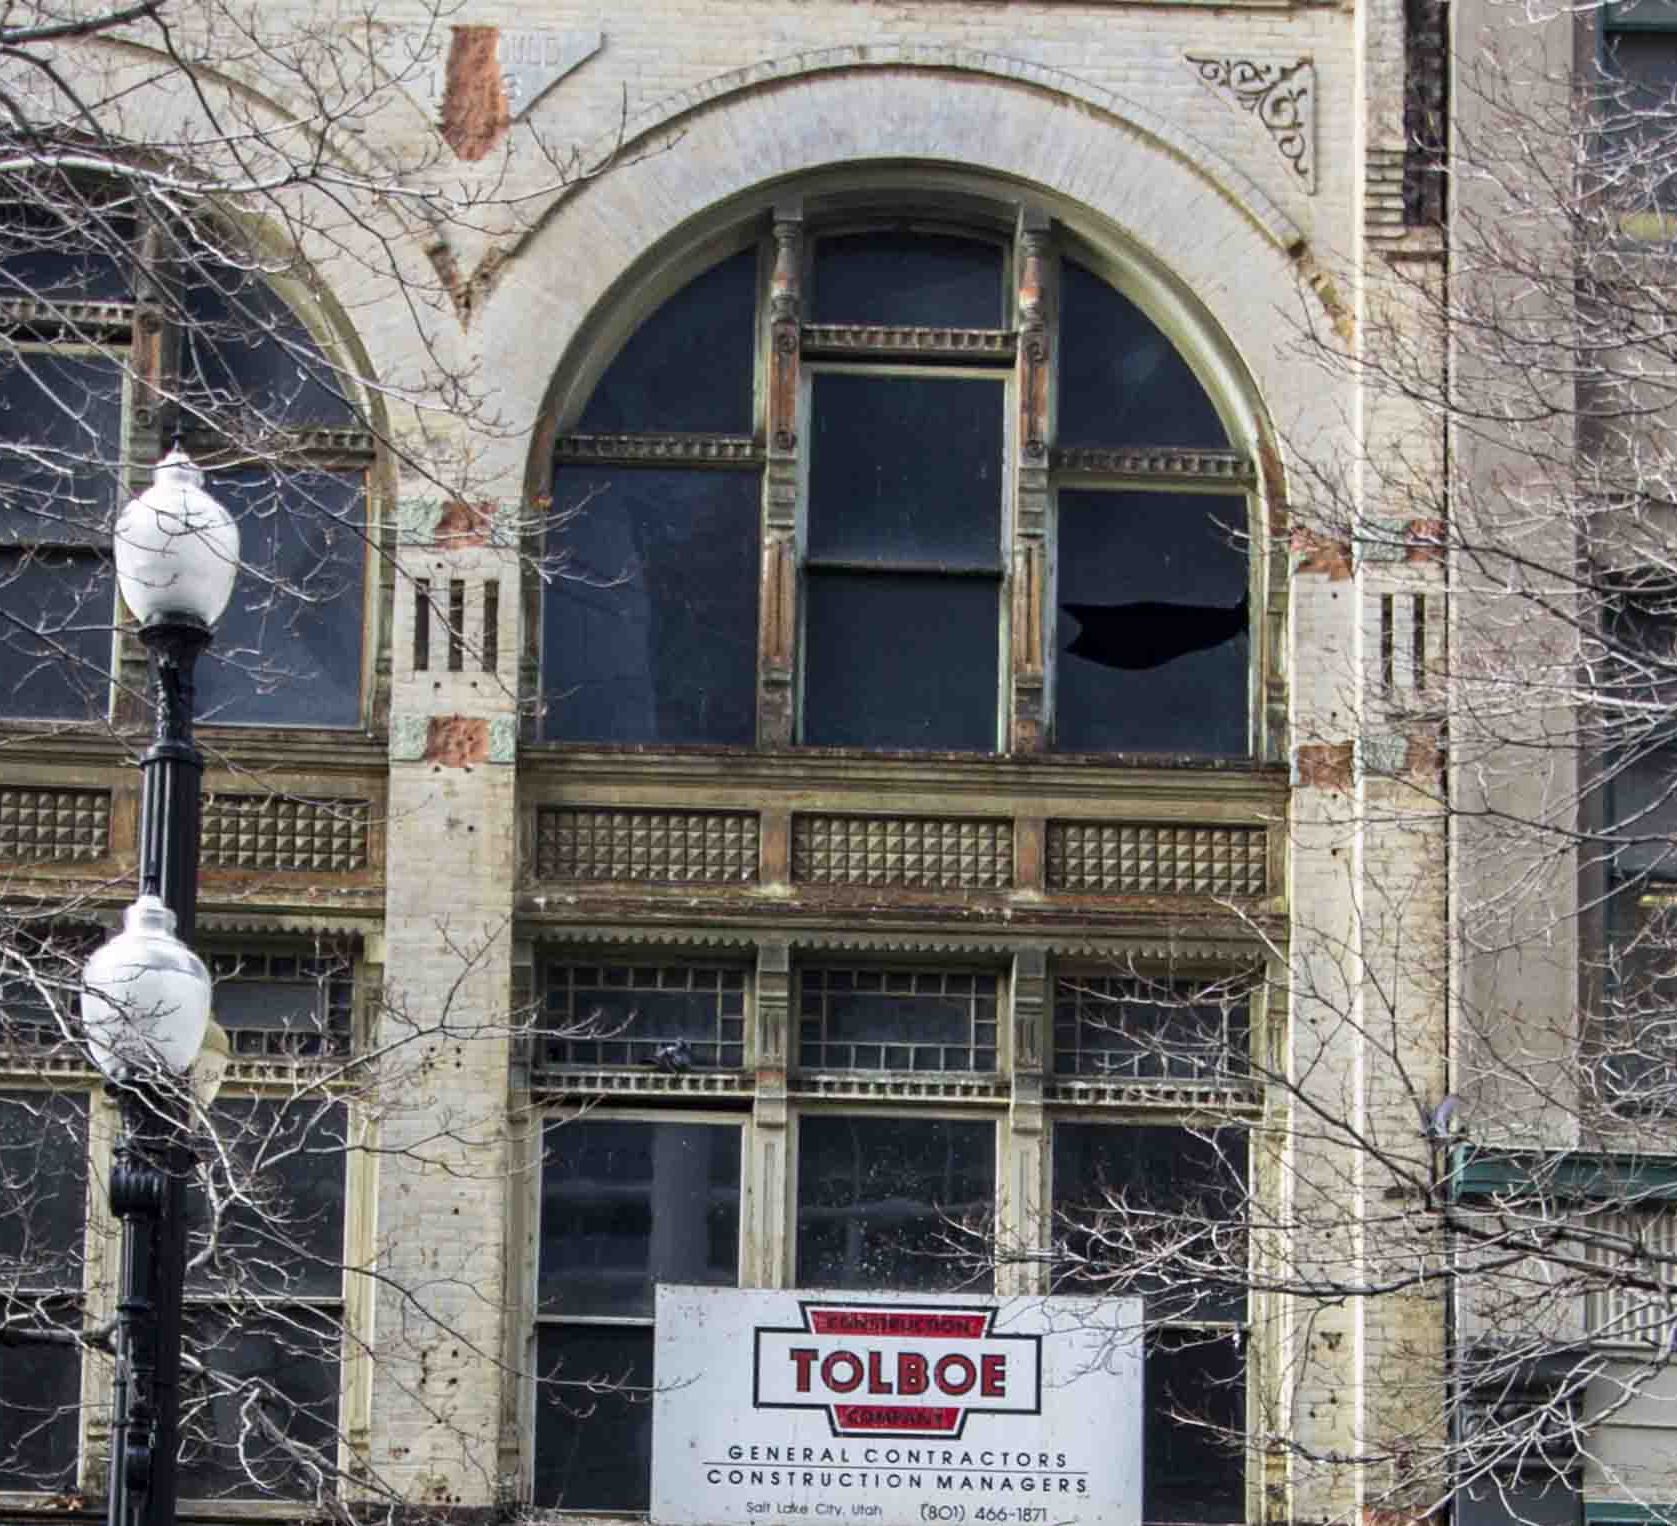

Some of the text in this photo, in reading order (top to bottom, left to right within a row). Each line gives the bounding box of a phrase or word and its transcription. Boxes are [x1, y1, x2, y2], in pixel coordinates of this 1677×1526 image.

[826, 1314, 971, 1334] CONSTRUCTION
[789, 1347, 1007, 1398] TOLBOE
[845, 1408, 944, 1425] COMPANY
[727, 1445, 1068, 1468] GENERAL CONTRACTORS
[706, 1469, 1088, 1493] CONSTRUCTION MANAGERS
[745, 1501, 771, 1514] Salt
[776, 1502, 809, 1515] Lake
[851, 1504, 883, 1517] Utah
[919, 1502, 967, 1523] (801)
[974, 1506, 1048, 1523] 466-1871
